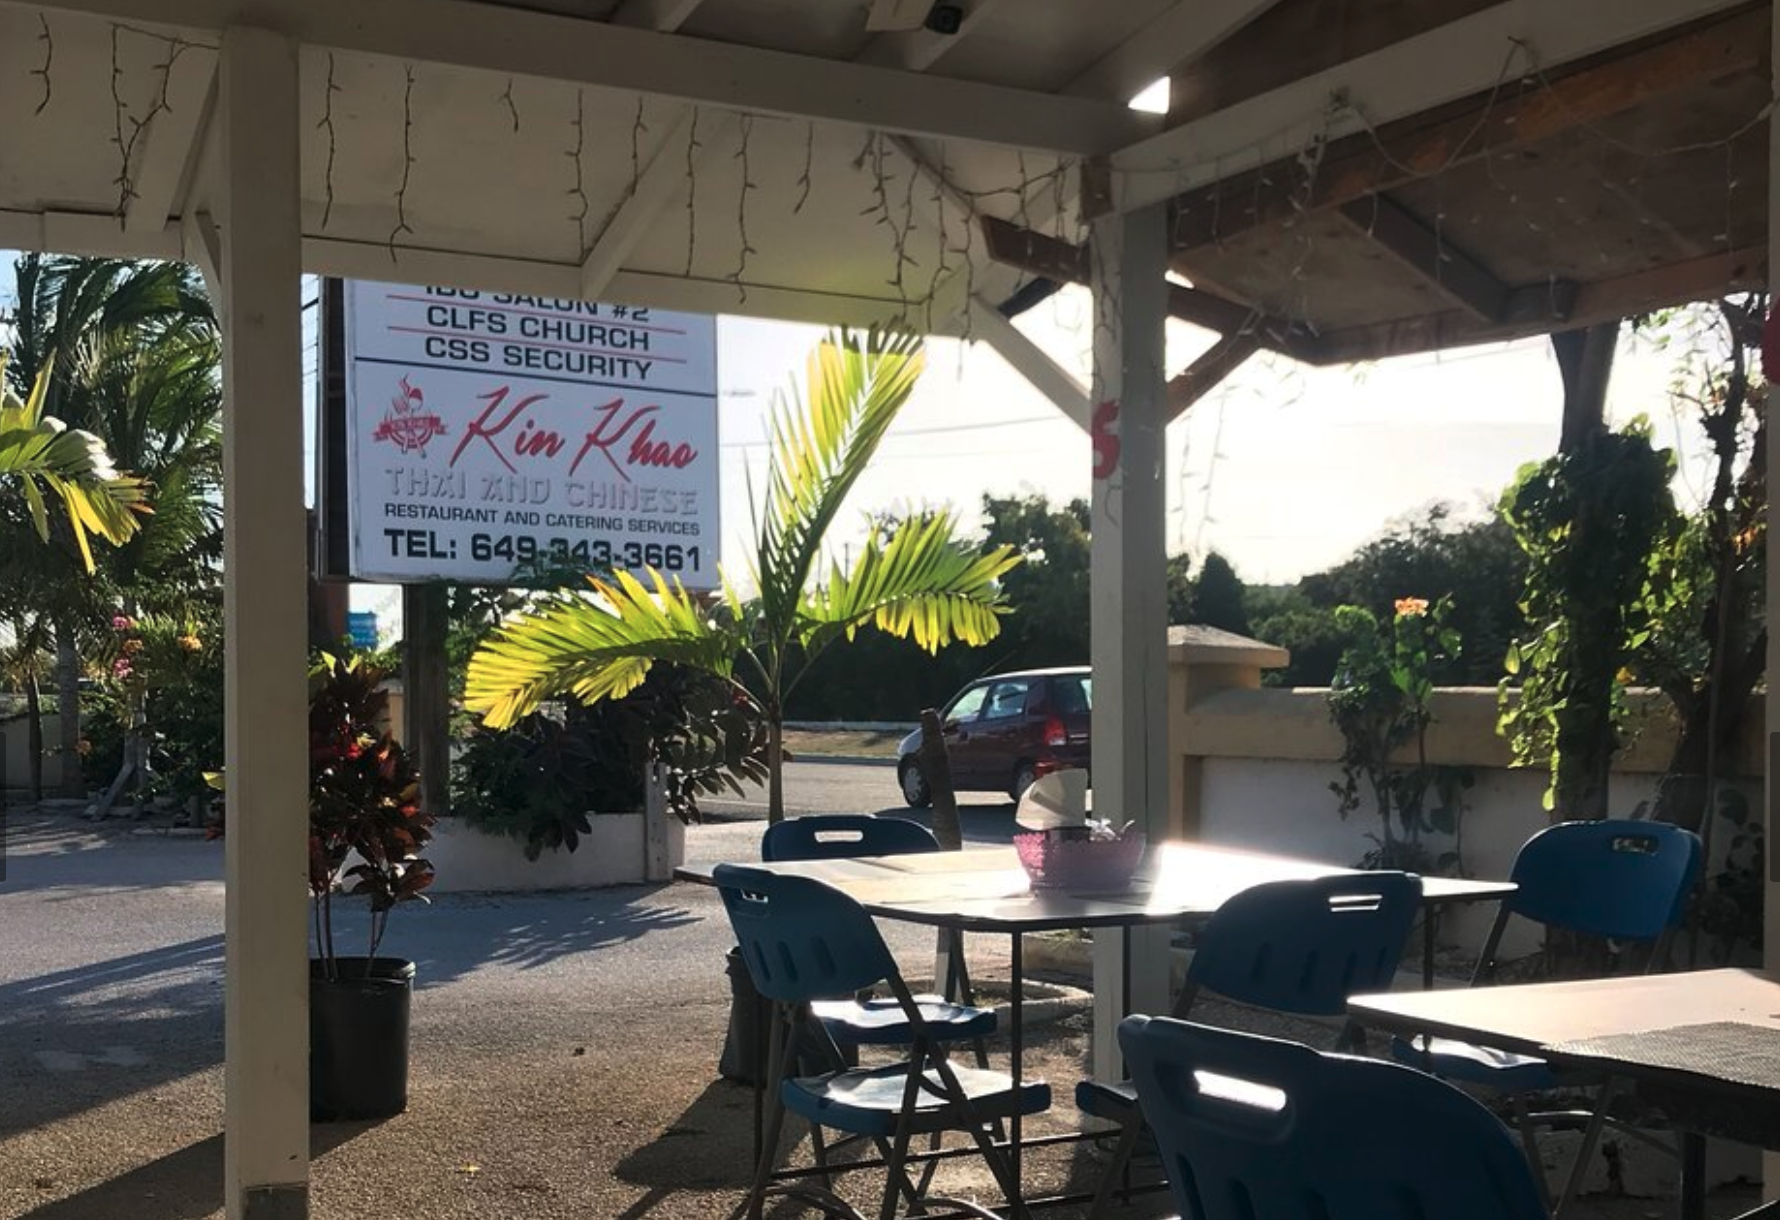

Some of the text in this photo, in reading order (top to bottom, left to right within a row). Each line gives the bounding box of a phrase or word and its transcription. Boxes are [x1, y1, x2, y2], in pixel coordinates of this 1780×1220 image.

[427, 305, 649, 351] CLFS CHURCH
[426, 336, 652, 380] CSS SECURITY
[450, 386, 698, 482] Kin Khao
[385, 467, 699, 515] THAI AND CHINESE
[385, 503, 700, 536] RESTAURANT AND CATERING SERVICES
[384, 528, 699, 571] TEL: 649-343-3661
